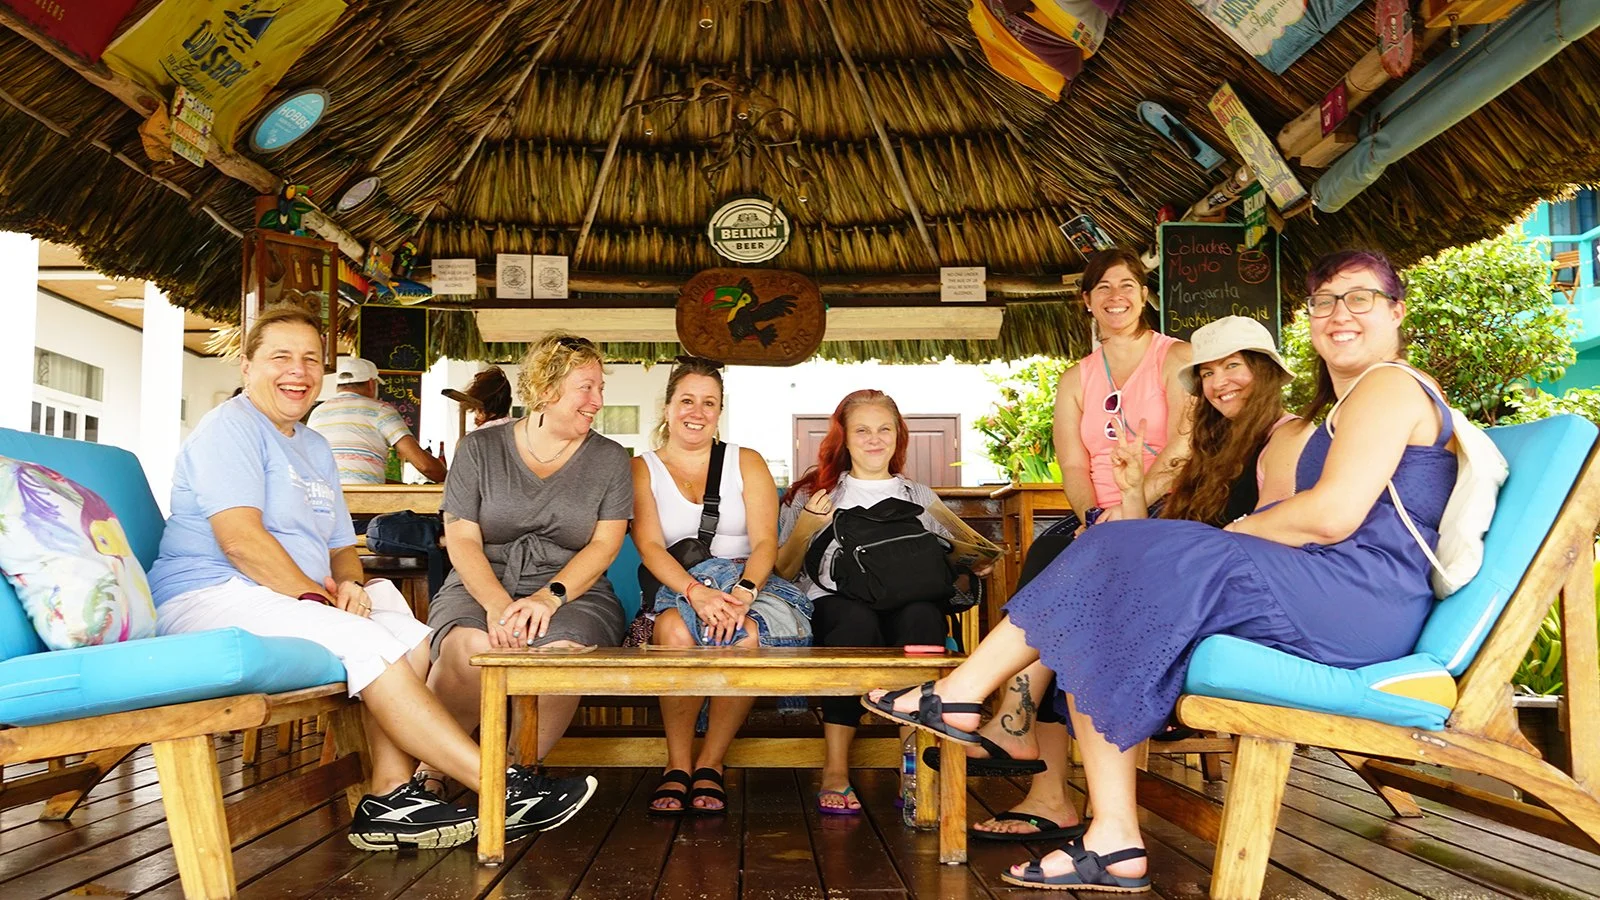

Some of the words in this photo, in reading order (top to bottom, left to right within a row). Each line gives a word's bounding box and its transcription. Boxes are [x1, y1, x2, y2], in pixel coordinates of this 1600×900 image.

[278, 106, 310, 129] HOBBS
[721, 227, 777, 240] BELIKIN
[736, 242, 764, 250] BEER
[1169, 281, 1240, 308] Margarita
[384, 382, 406, 398] day
